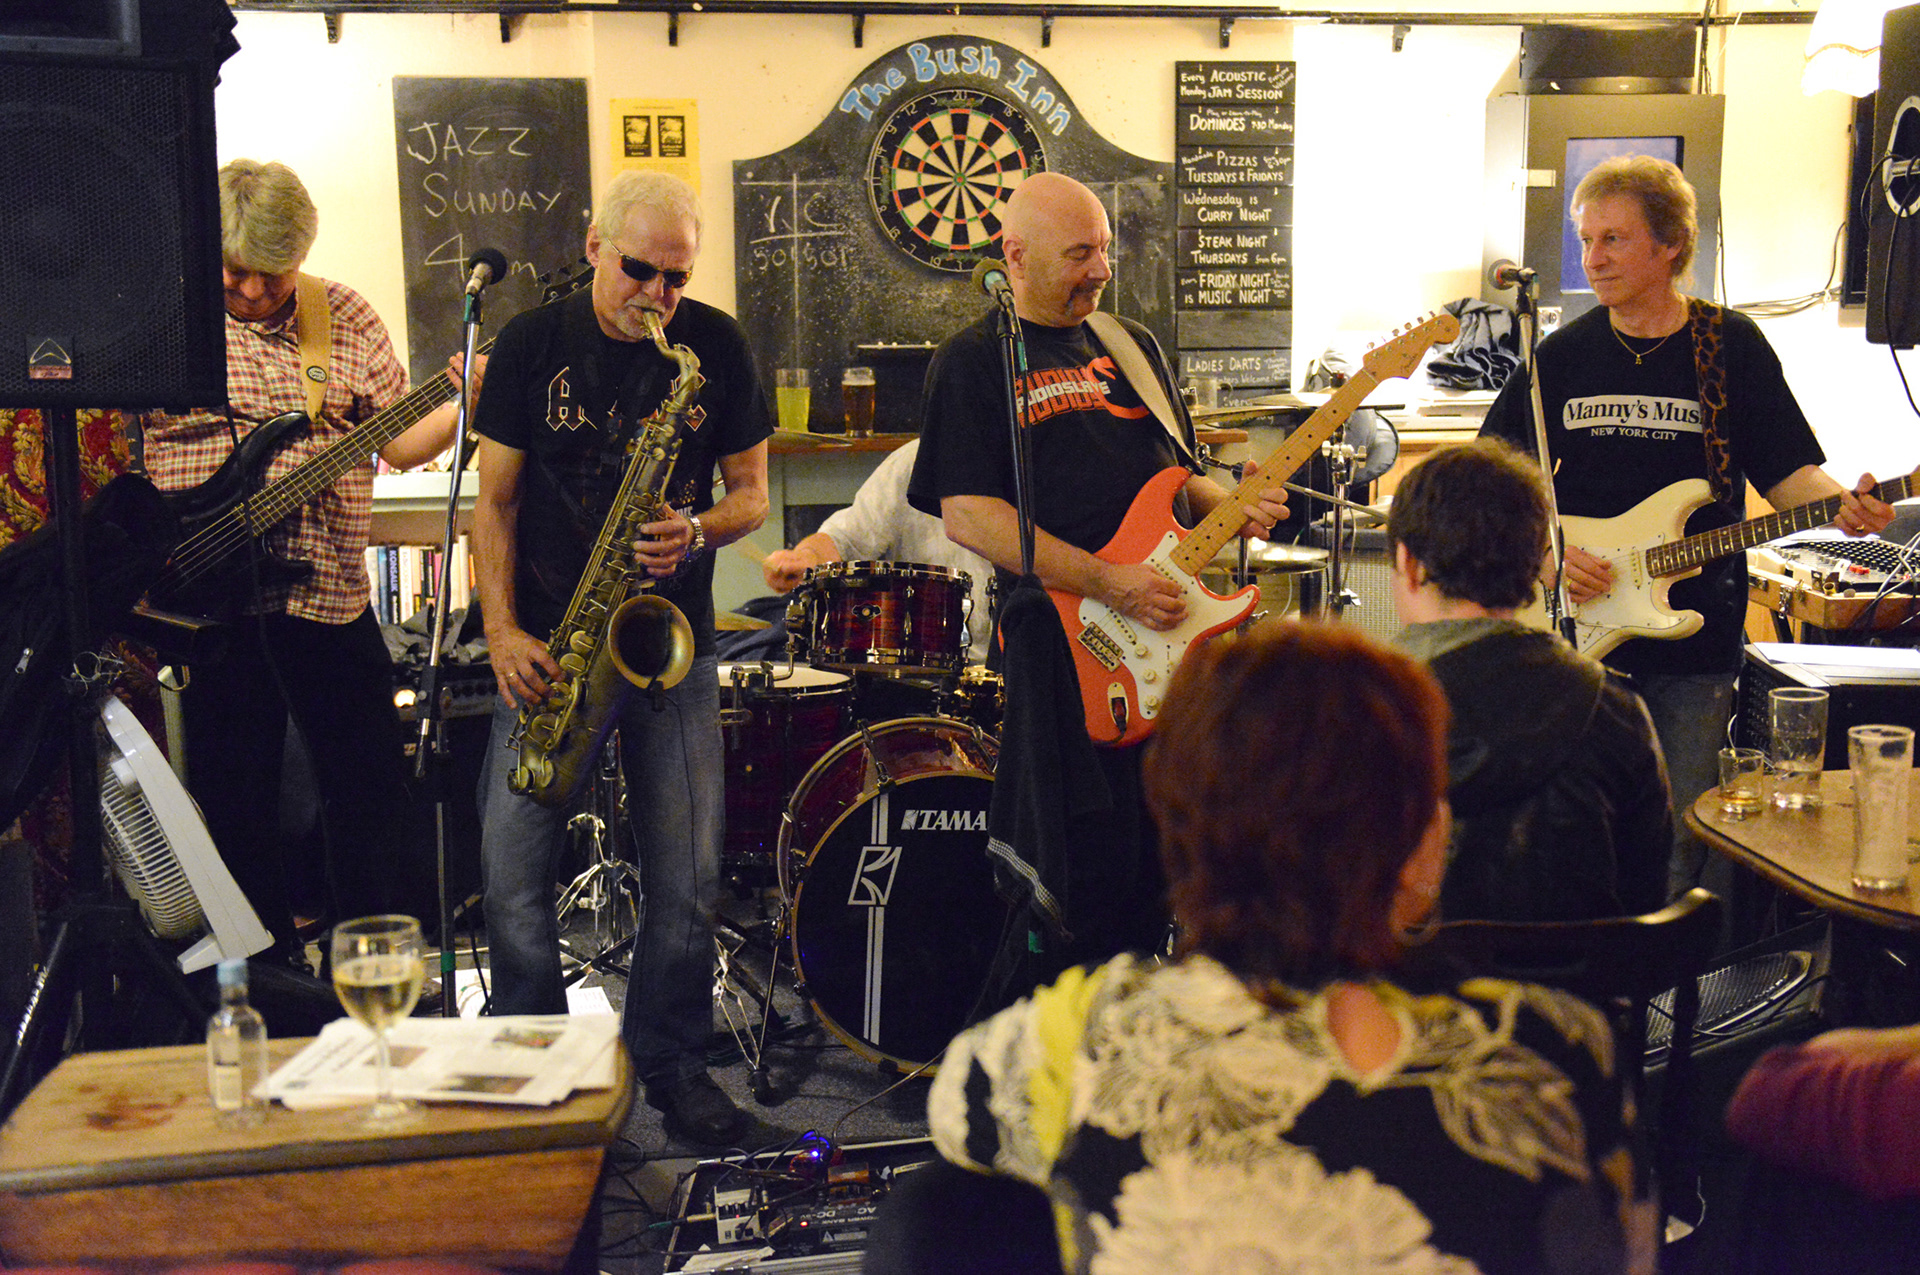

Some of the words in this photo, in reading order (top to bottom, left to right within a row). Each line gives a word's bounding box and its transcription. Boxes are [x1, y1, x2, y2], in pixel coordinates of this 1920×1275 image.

[1181, 73, 1205, 84] Every
[1210, 69, 1266, 82] ACOUSTIC
[840, 67, 906, 121] The
[907, 43, 1001, 82] Bush
[1005, 58, 1071, 136] Inn
[953, 90, 967, 101] 20
[1180, 85, 1206, 99] Monday
[1208, 86, 1232, 98] JAM
[1236, 84, 1283, 99] SESSION
[1189, 114, 1245, 131] DOMINOES
[407, 122, 531, 164] JAZZ
[1217, 150, 1258, 167] PIZZAS
[1185, 167, 1237, 183] TUESDAYS
[1247, 168, 1283, 182] FRIDAYS
[423, 172, 561, 217] SUNDAY
[1183, 192, 1243, 207] Wednesday
[1197, 207, 1233, 222] CURRY
[1240, 208, 1272, 222] NIGHT
[1198, 235, 1232, 248] STEAK
[1237, 234, 1268, 248] NIGHT
[1190, 250, 1248, 264] THURSDAYS
[1199, 273, 1237, 288] FRIDAY
[1240, 273, 1271, 287] NIGHT
[1198, 290, 1232, 304] MUSIC
[1239, 289, 1271, 303] NIGHT
[1187, 357, 1223, 372] LADIES
[1229, 357, 1260, 371] DARTS
[1016, 381, 1111, 413] AUDIOSLAVE
[1566, 399, 1649, 424] Manny's
[1652, 401, 1704, 425] Mus
[1591, 427, 1616, 437] NEW
[1618, 427, 1649, 439] YORK
[1652, 431, 1678, 441] CITY
[389, 550, 399, 592] KONSALIK
[918, 810, 988, 831] TAMA
